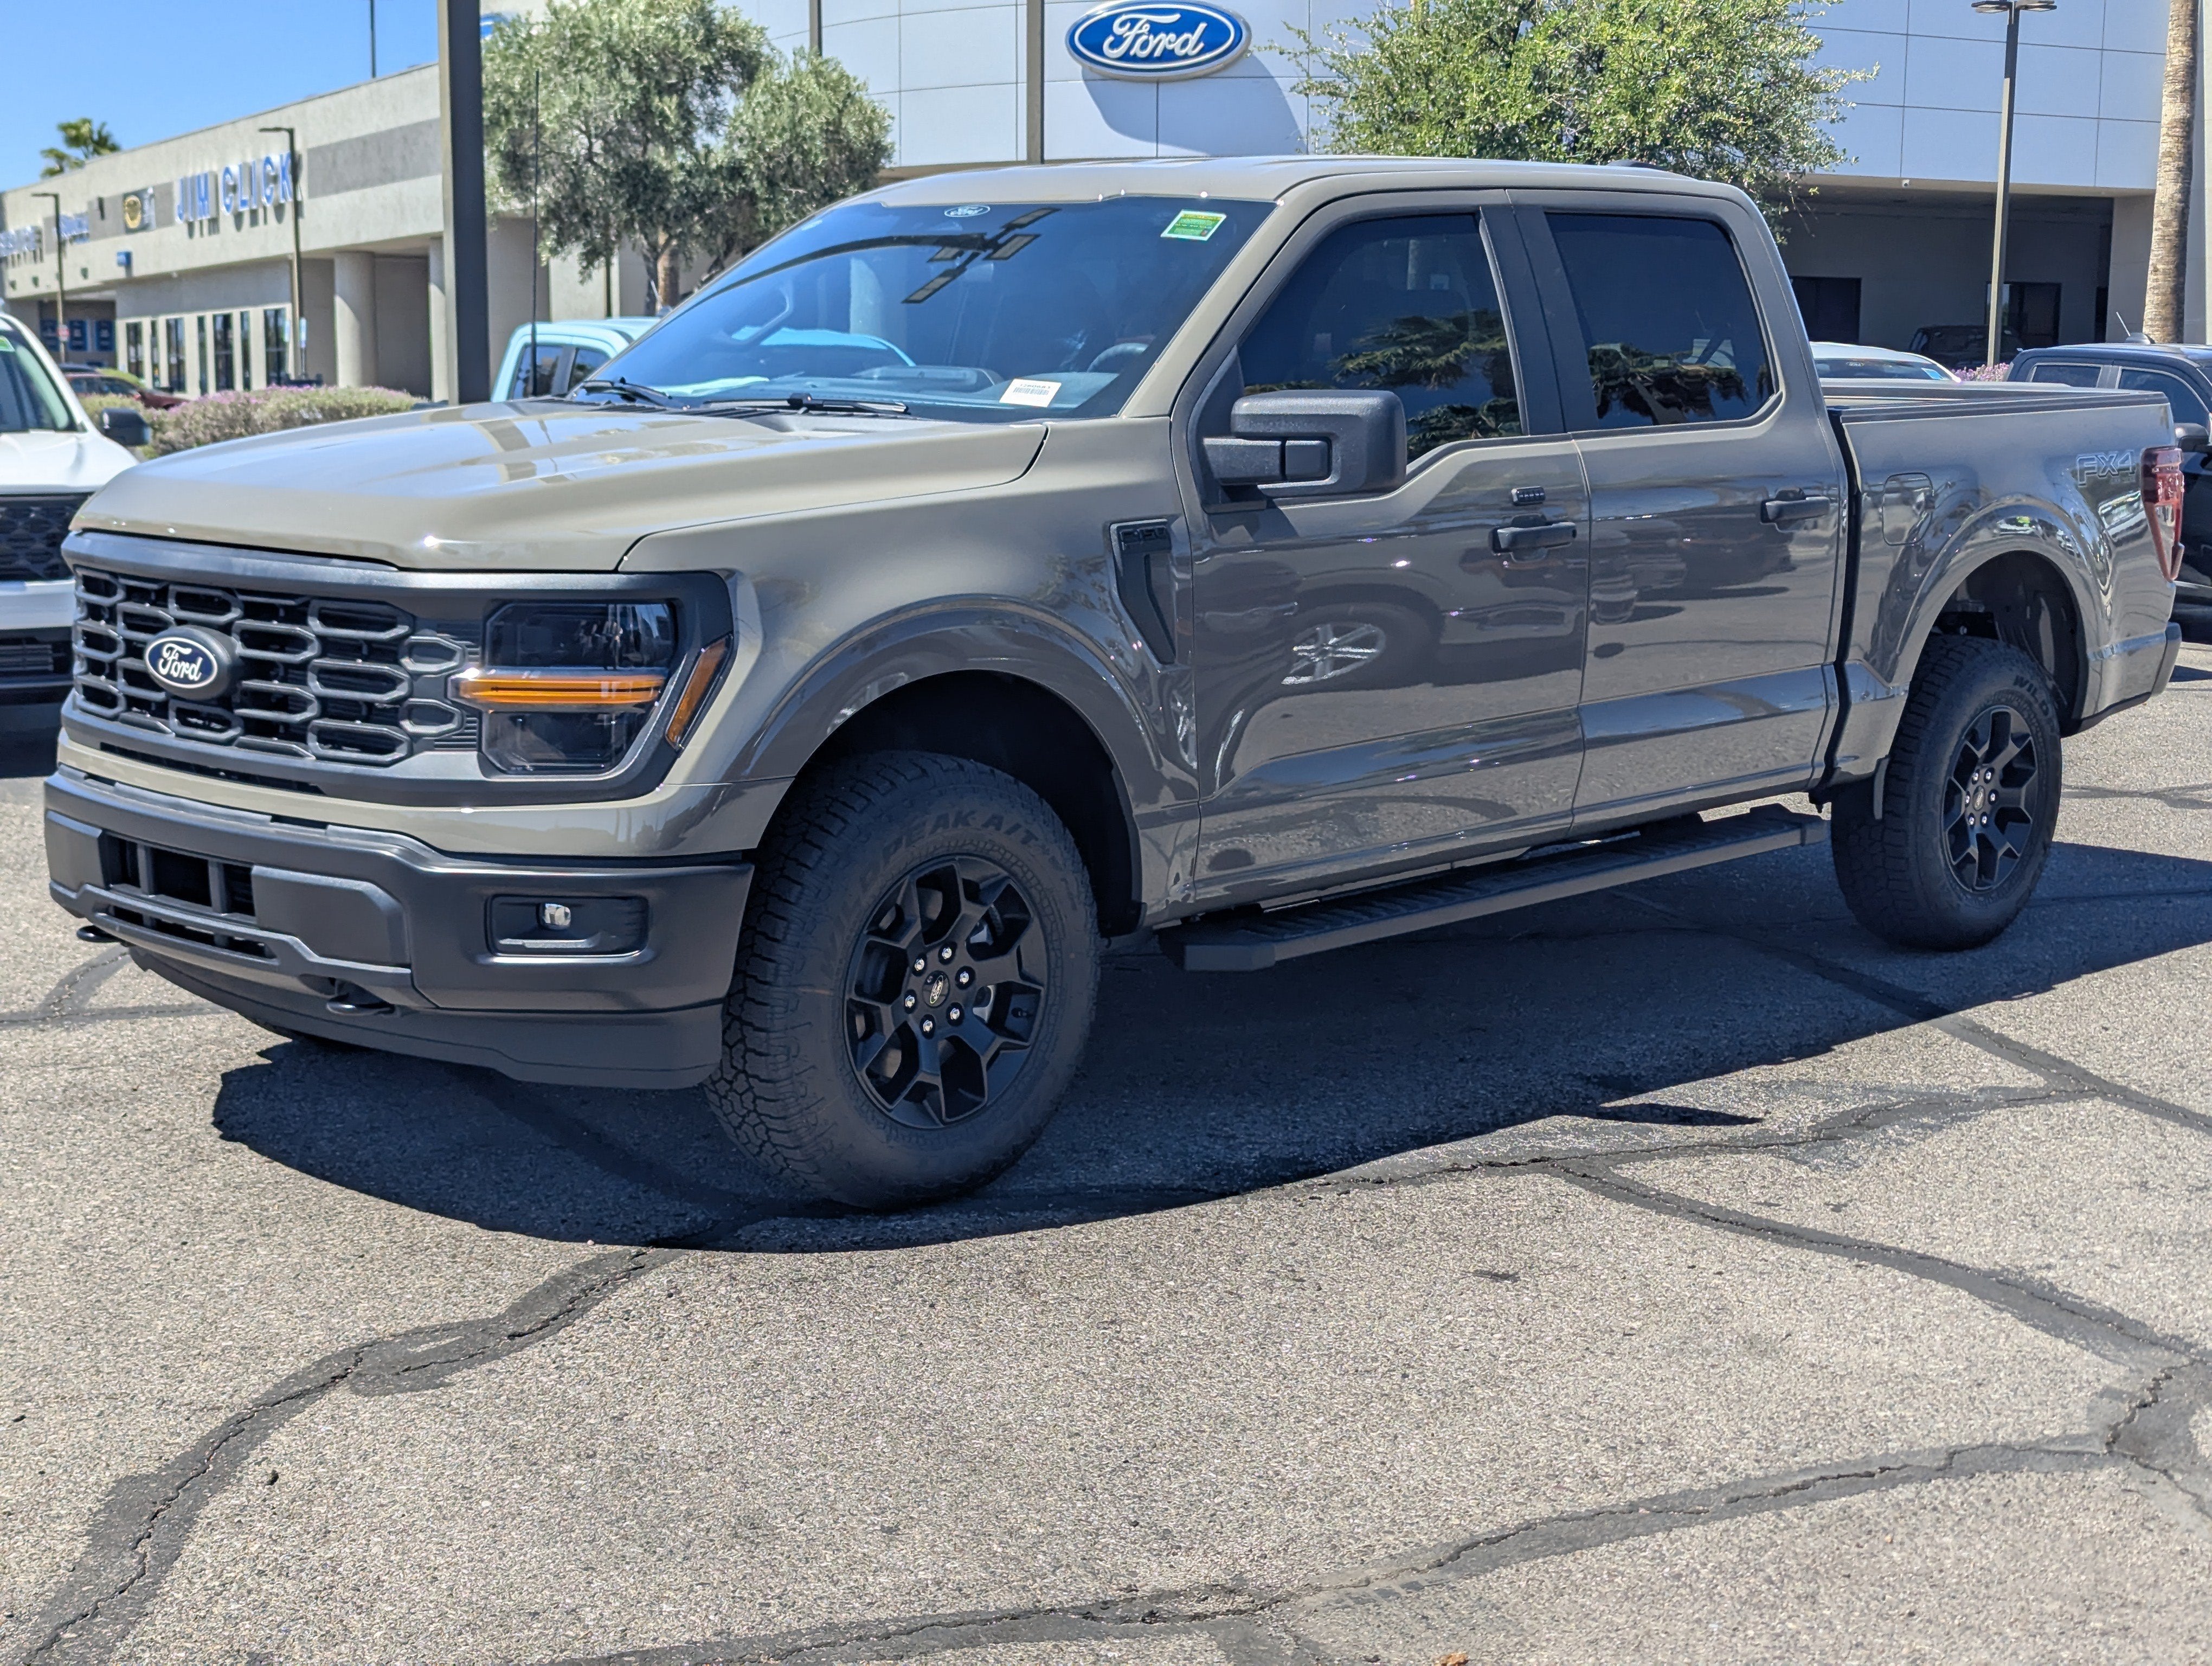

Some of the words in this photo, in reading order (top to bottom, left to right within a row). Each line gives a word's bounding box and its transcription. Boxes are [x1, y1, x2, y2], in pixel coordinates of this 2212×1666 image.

[1103, 14, 1207, 58] Ford
[176, 172, 210, 223] JIM
[221, 151, 293, 215] CLICK
[2076, 451, 2136, 487] FX4
[158, 643, 203, 681] Ford
